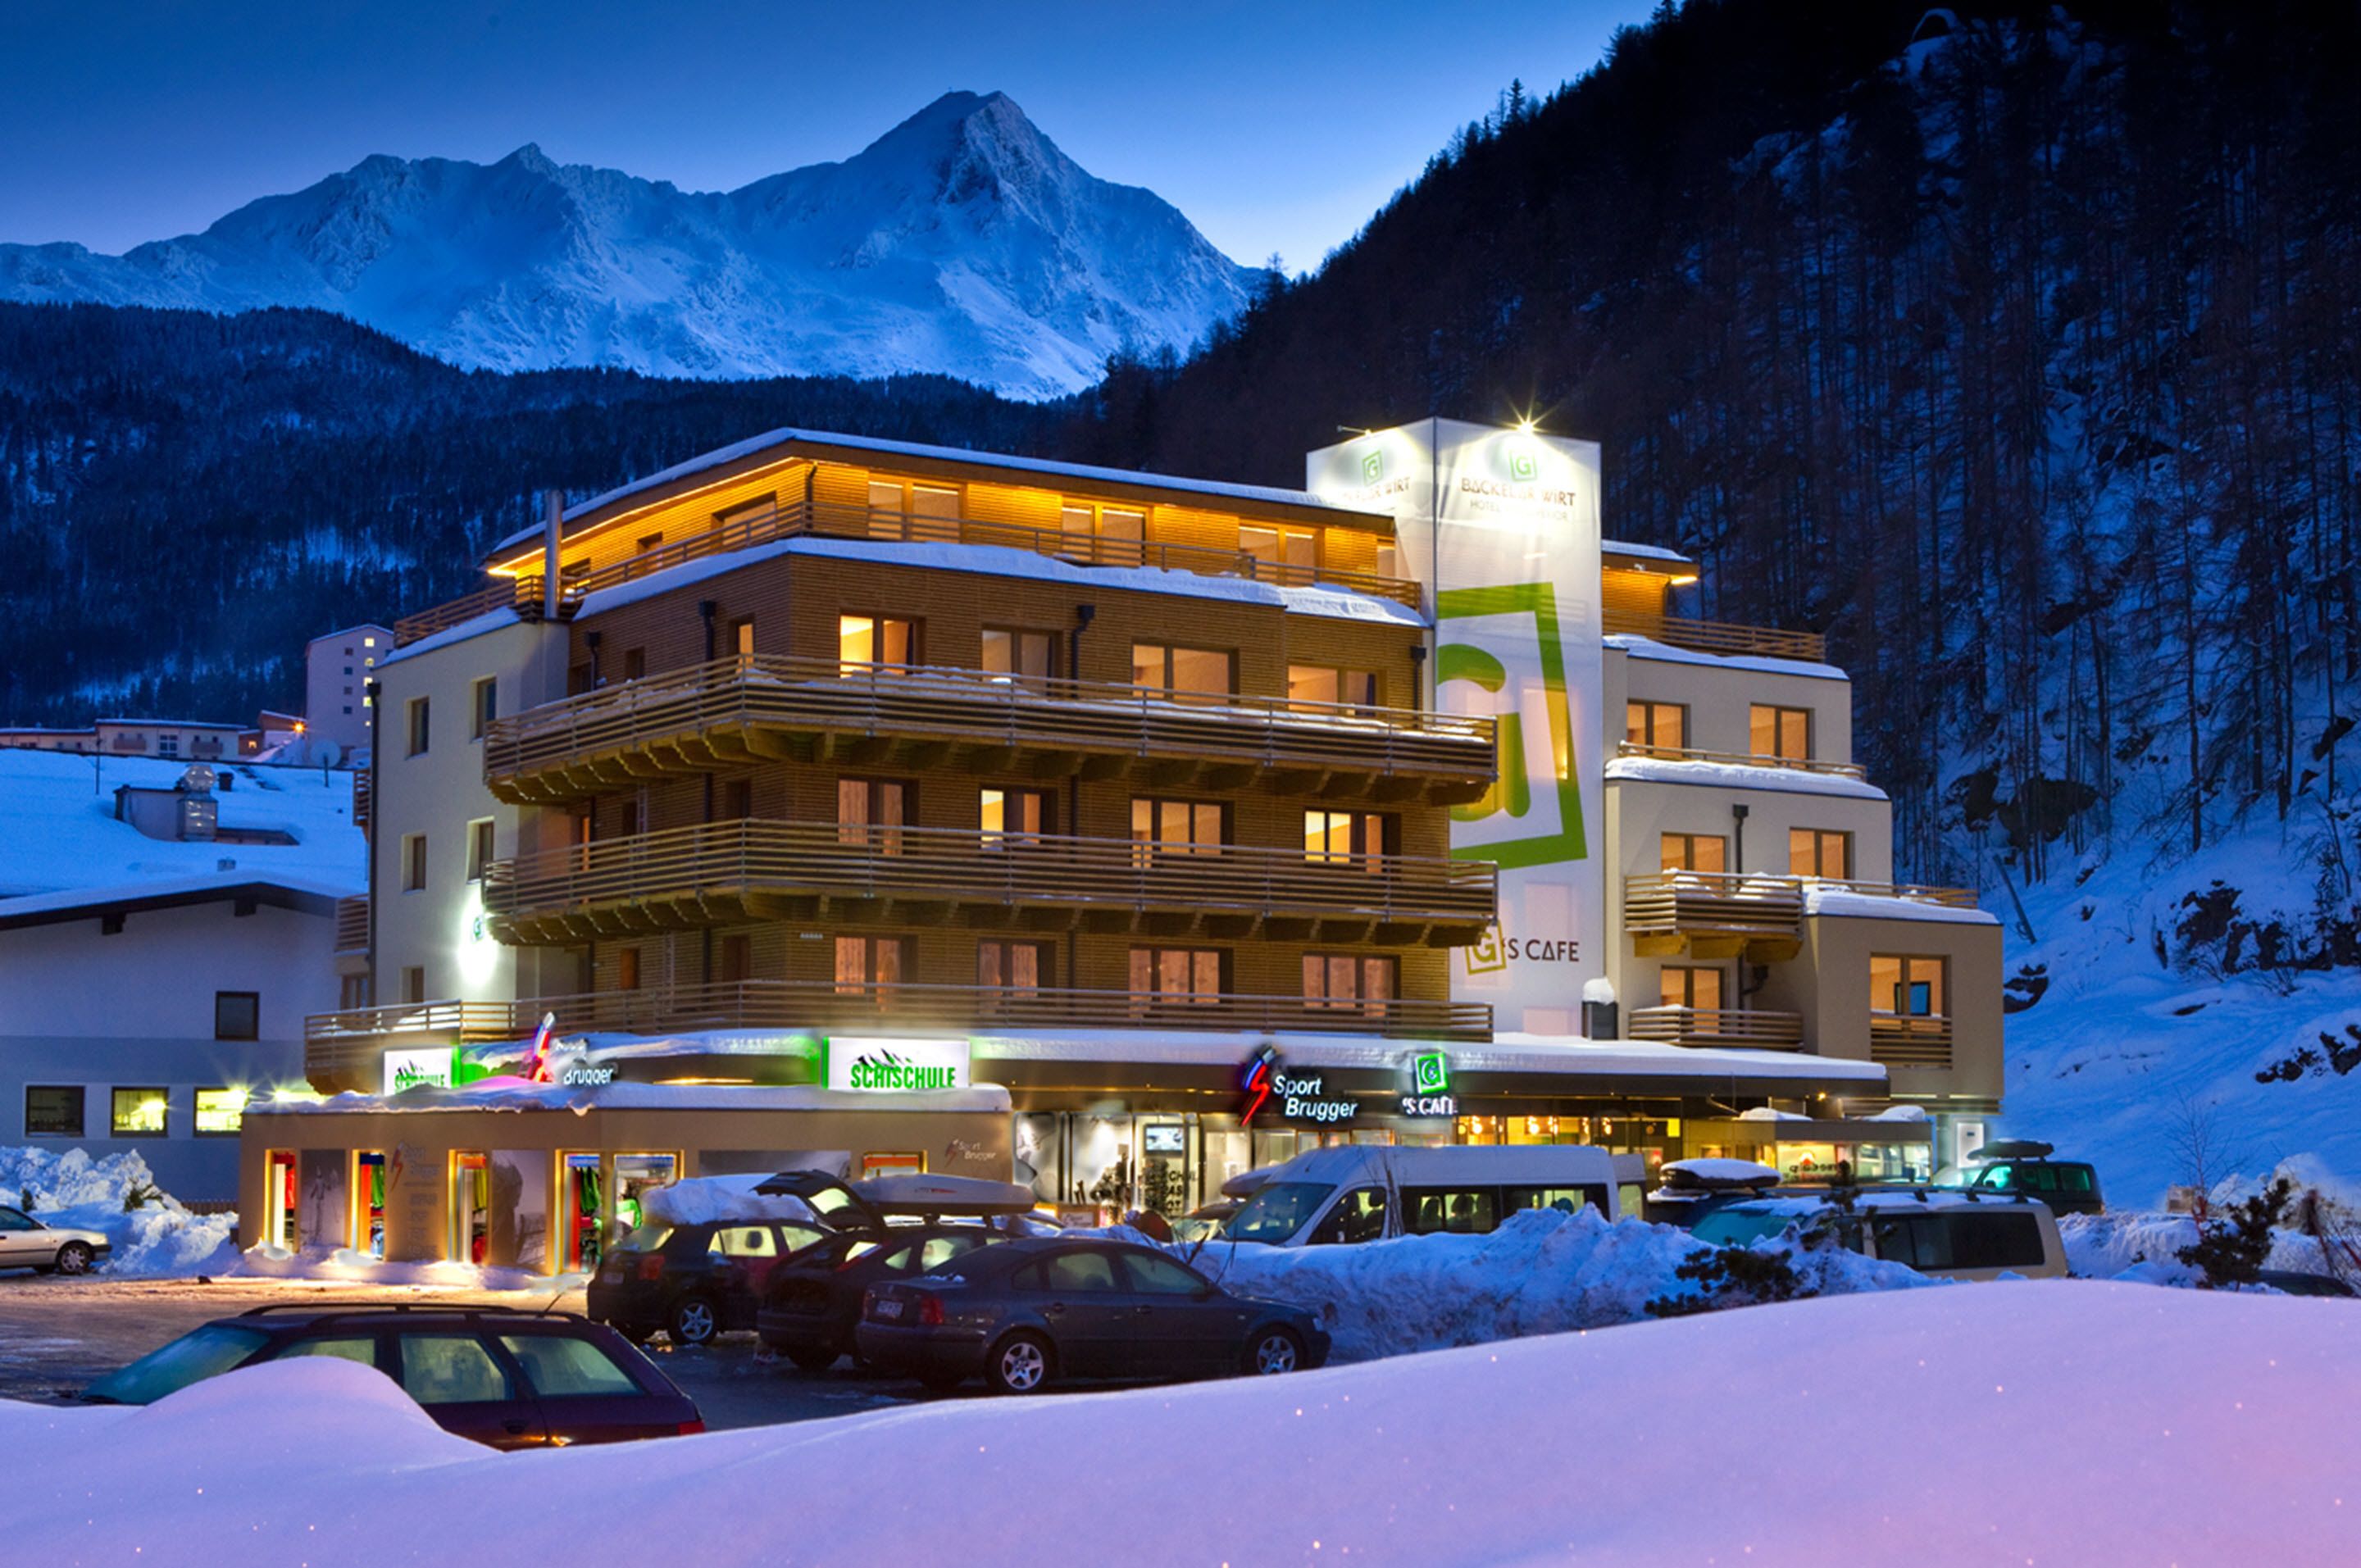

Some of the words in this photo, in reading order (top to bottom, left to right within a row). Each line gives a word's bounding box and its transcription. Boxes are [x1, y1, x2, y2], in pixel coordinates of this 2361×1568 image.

[1541, 489, 1576, 507] WIRT
[1472, 932, 1496, 963] G
[1525, 939, 1580, 962] CAFE
[850, 1063, 956, 1089] SCHISCHULE
[1273, 1074, 1322, 1099] Sport
[1285, 1097, 1358, 1122] Brugger
